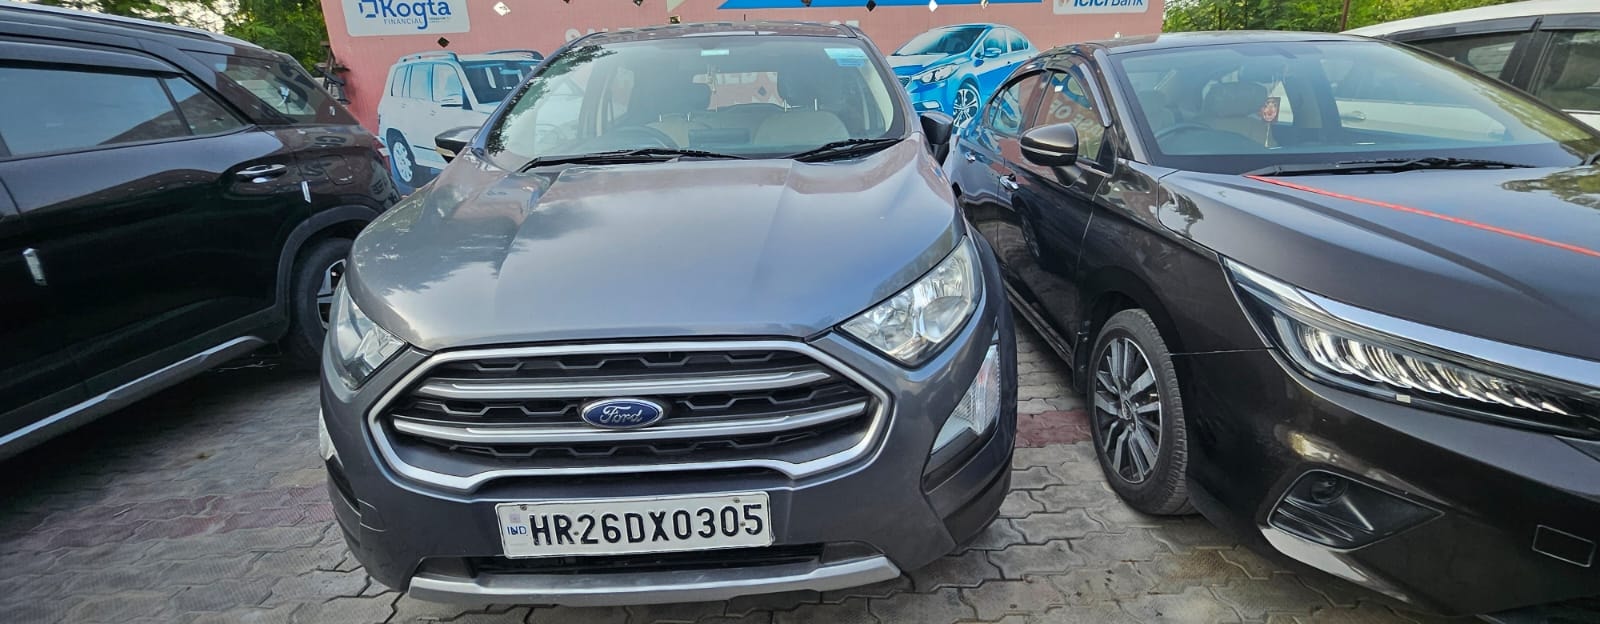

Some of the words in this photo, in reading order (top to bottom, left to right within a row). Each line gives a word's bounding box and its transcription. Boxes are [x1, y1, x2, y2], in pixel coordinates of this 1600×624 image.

[379, 0, 452, 29] Kogta
[383, 17, 423, 25] FINANCIAL
[599, 405, 643, 425] Ford
[529, 503, 764, 546] HR26DX0305
